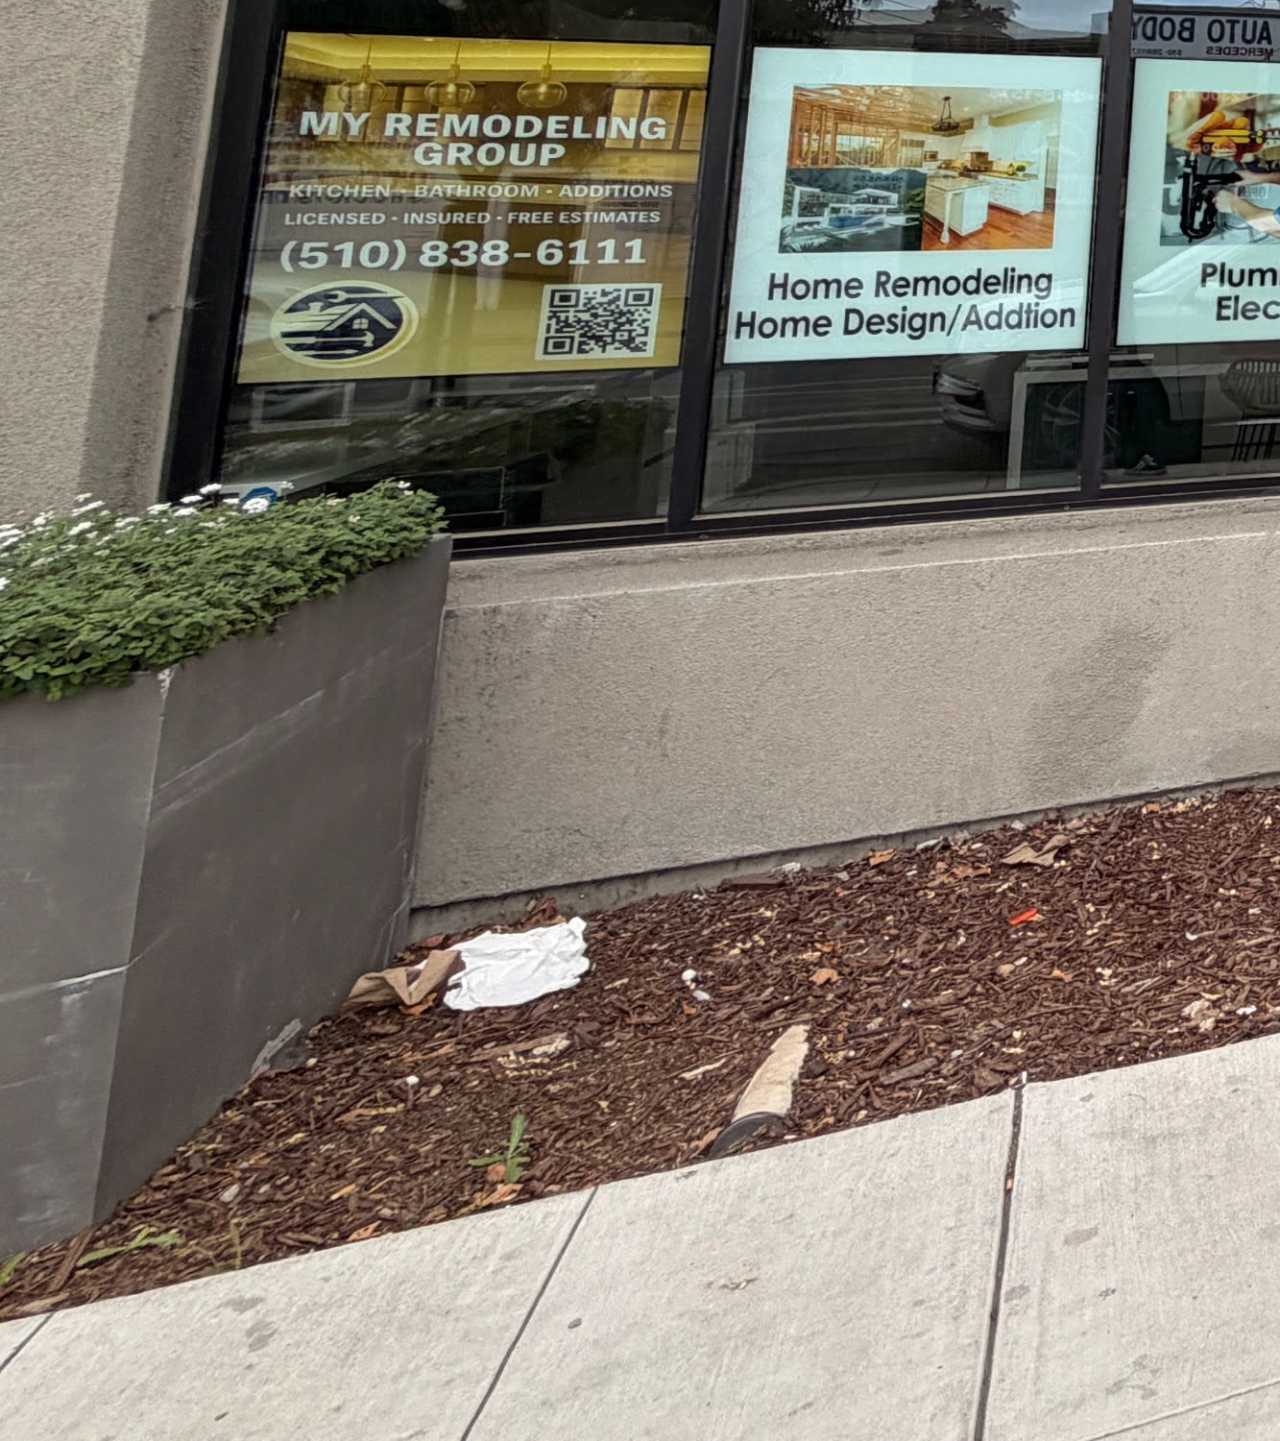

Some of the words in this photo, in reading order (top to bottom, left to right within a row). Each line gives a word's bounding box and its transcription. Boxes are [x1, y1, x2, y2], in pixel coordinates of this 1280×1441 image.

[300, 111, 369, 137] MY
[384, 112, 667, 140] REMODELING
[413, 142, 566, 167] GROUP
[289, 184, 391, 199] KITCHEN
[414, 184, 540, 199] BATHROOM
[558, 183, 674, 199] ADDITIONS
[284, 212, 386, 226] LICENSED
[402, 211, 490, 226] INSURED
[507, 211, 554, 225] FREE
[558, 210, 661, 225] ESTIMATES
[280, 239, 407, 273] (510)
[418, 237, 647, 268] 838-6111
[767, 272, 863, 301] Home
[874, 267, 1053, 301] Remodeling
[734, 311, 832, 340] Home
[843, 302, 1076, 342] Design/Addtion
